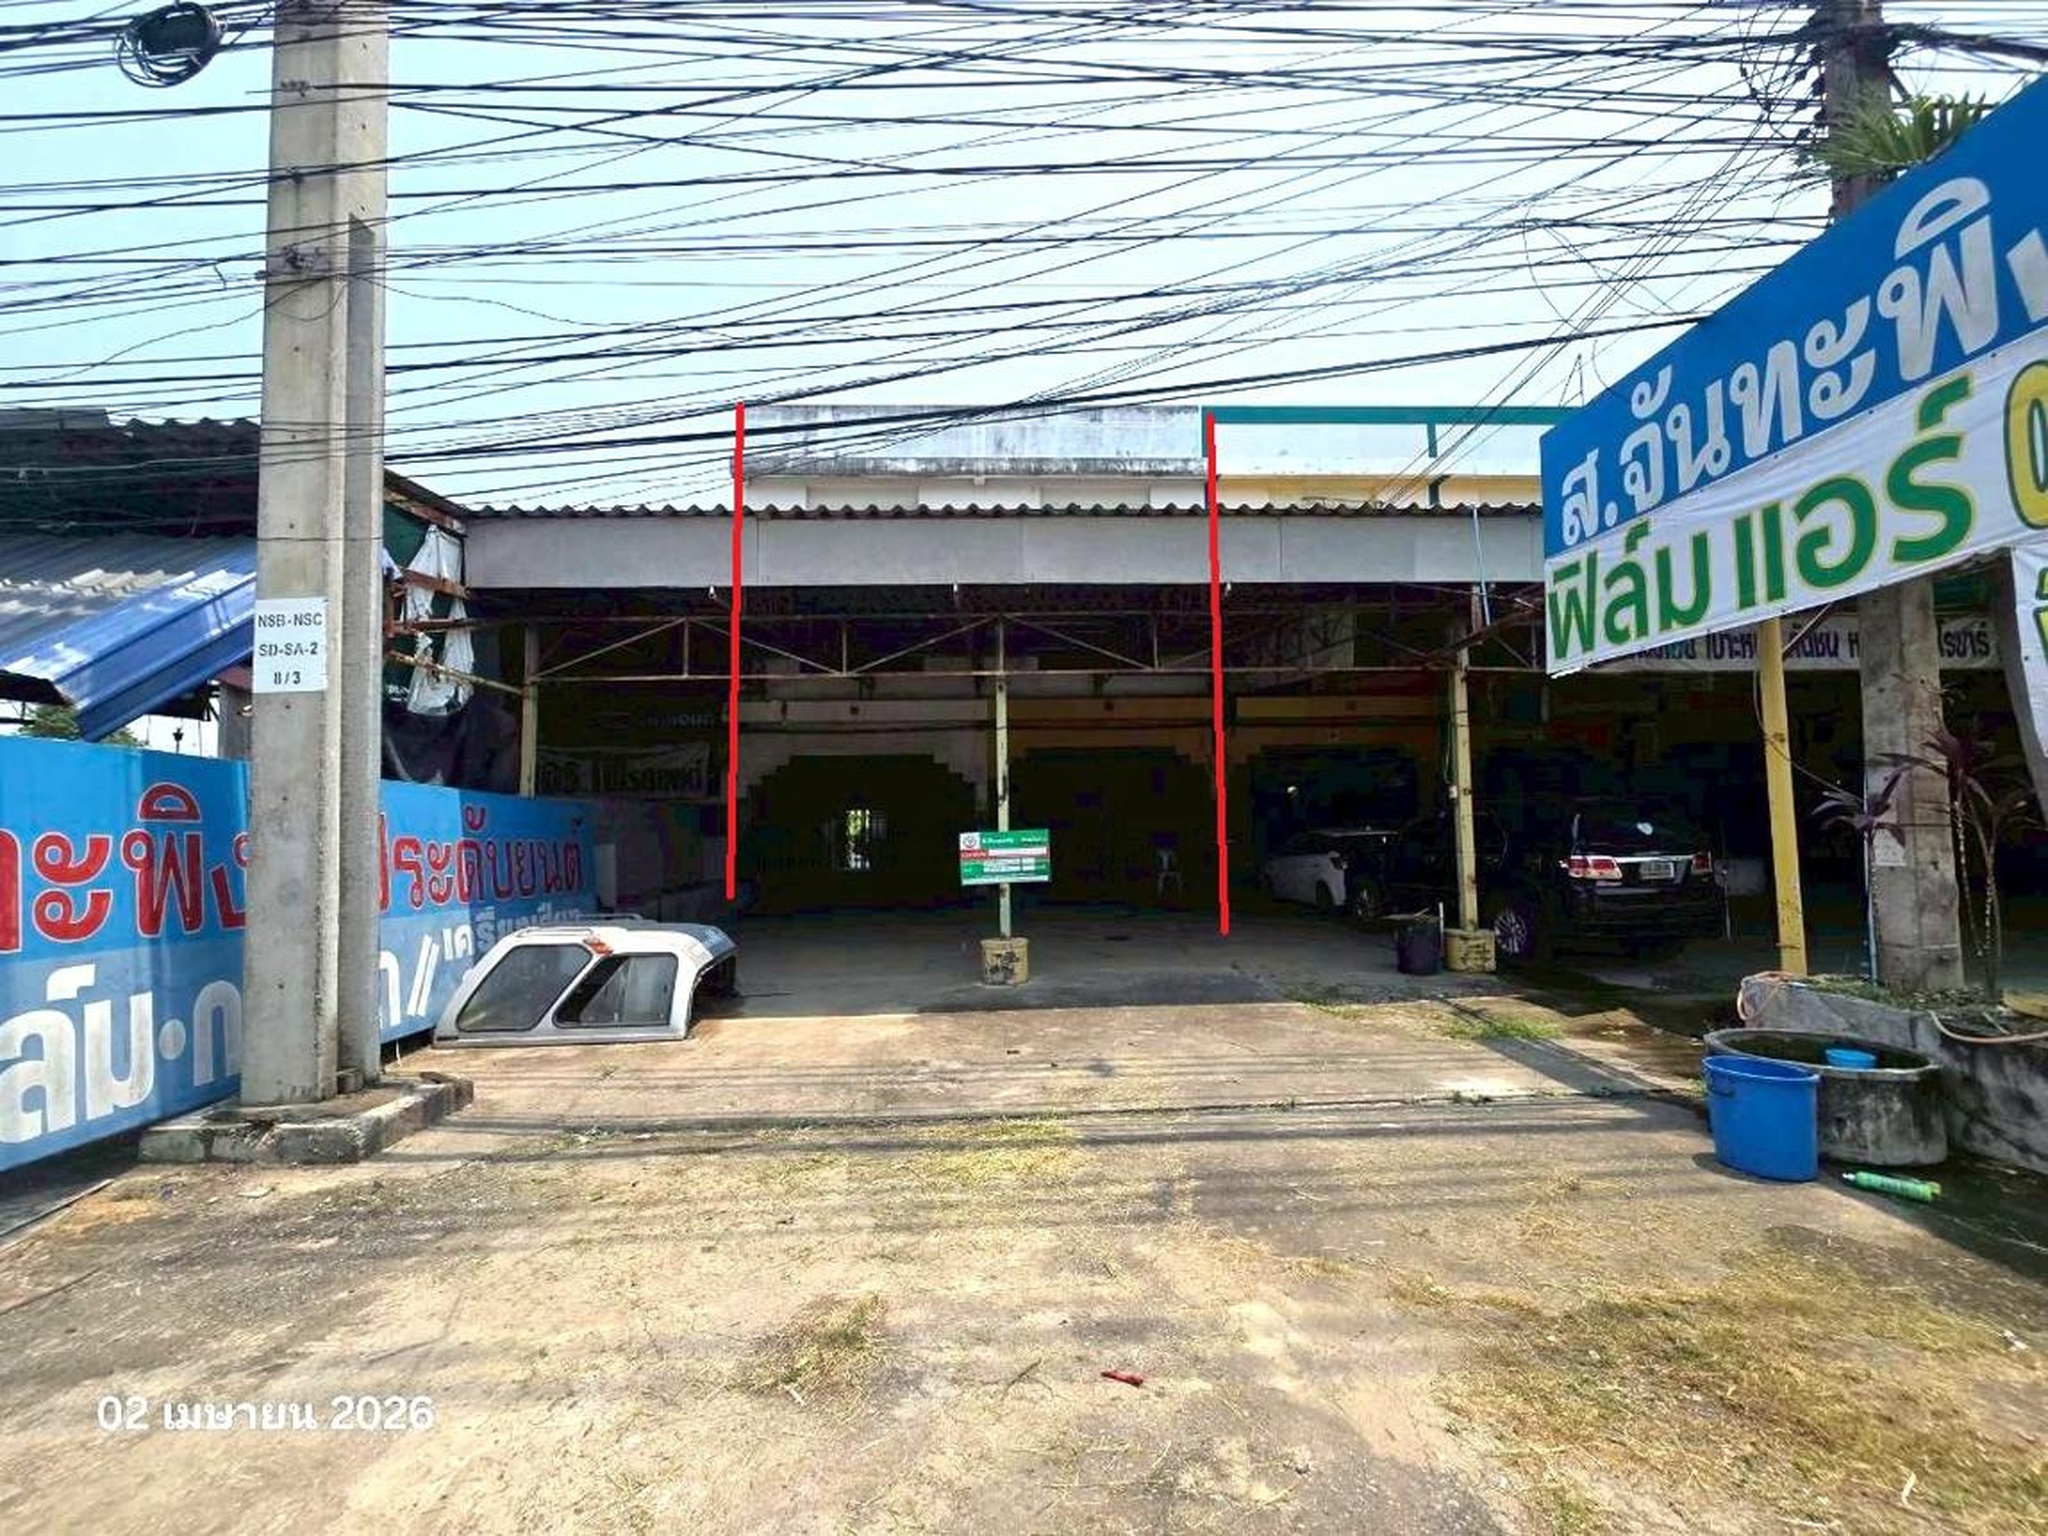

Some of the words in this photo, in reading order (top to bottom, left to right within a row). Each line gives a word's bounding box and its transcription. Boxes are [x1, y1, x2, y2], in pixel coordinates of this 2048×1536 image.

[1561, 177, 2048, 546] ส.จันทะพิ
[1732, 371, 1973, 611] แอร์
